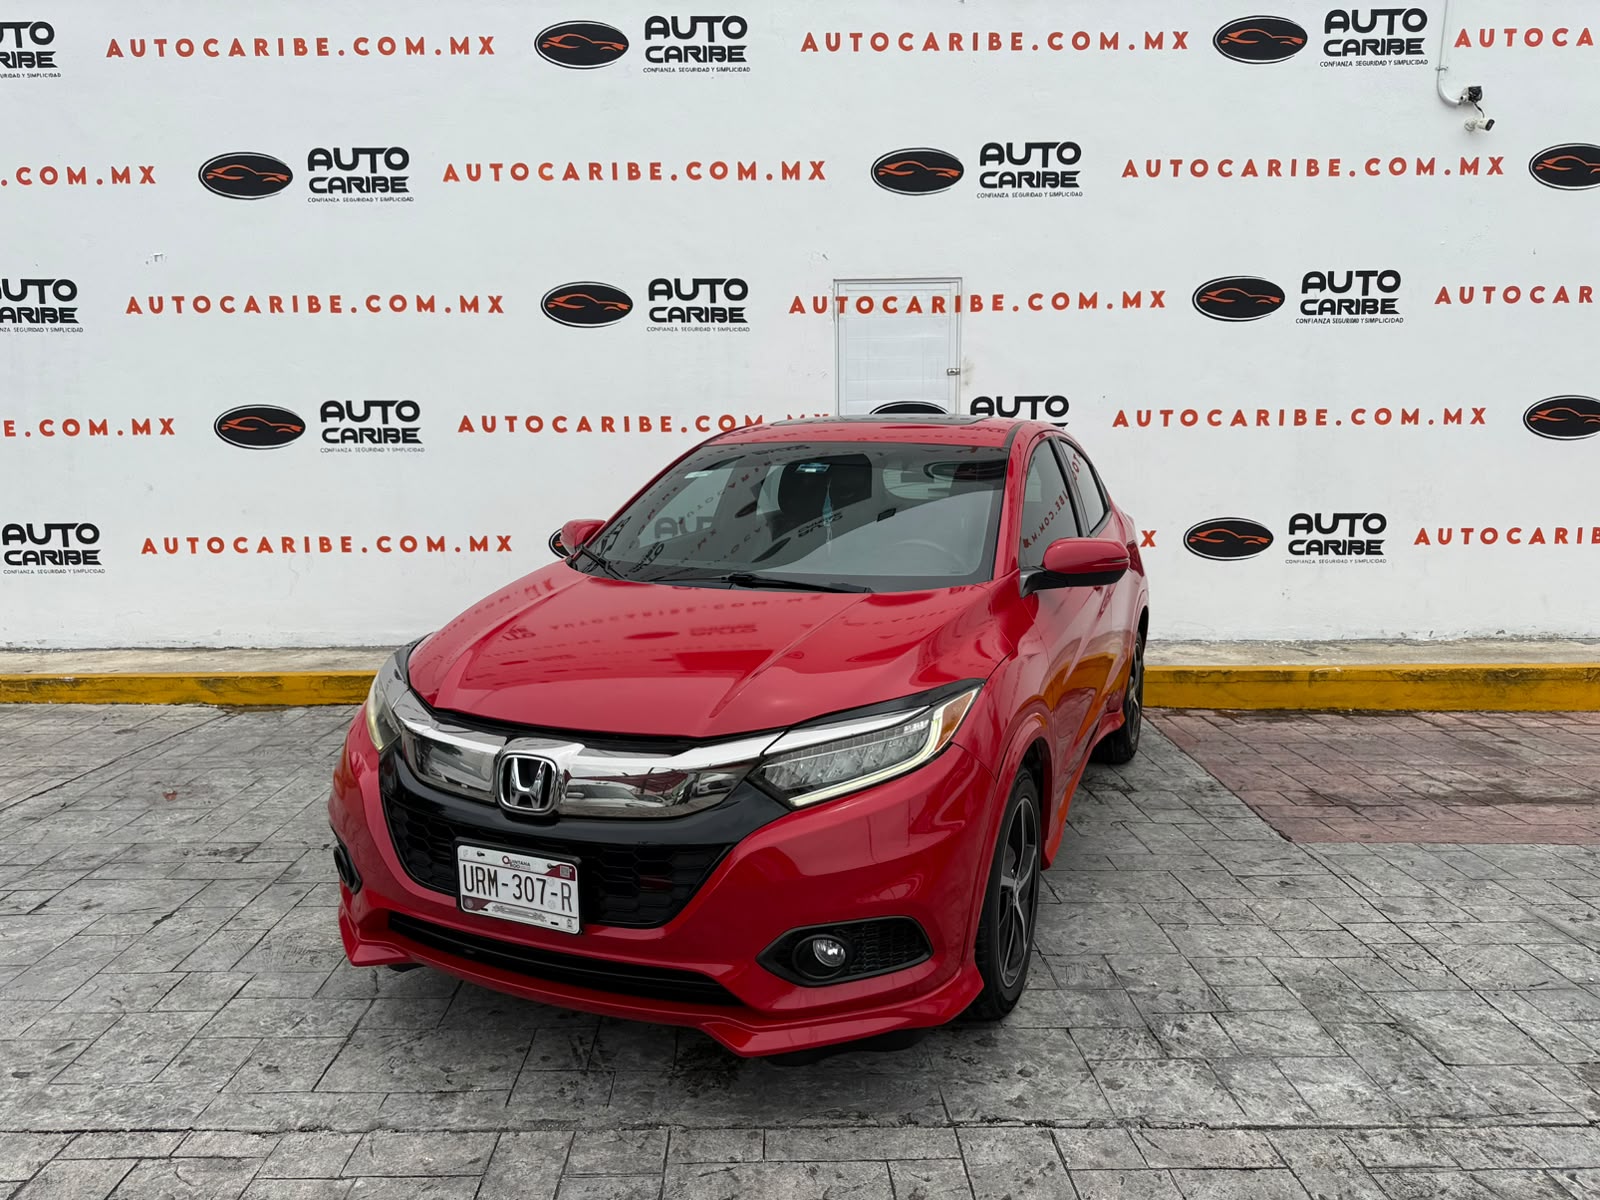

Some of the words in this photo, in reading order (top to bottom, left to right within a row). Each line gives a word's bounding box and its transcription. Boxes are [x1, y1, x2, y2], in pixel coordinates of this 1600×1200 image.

[645, 16, 747, 42] AUTO
[1325, 8, 1427, 35] AUTO
[0, 22, 54, 48] TO
[801, 31, 1188, 53] AUTOCARIBE.COM.MX
[107, 36, 495, 58] AUTOCARIBE.COM.MX
[645, 46, 747, 63] CARIBE
[1324, 38, 1426, 56] CARIBE
[308, 147, 409, 173] AUTO
[980, 142, 1081, 167] AUTO
[443, 160, 826, 183] AUTOCARIBE.COM.MX
[980, 170, 1081, 188] CARIBE
[1122, 157, 1503, 179] AUTOCARIBE.COM.MX
[309, 176, 410, 194] CARIBE
[0, 279, 77, 304] UTO
[649, 278, 748, 303] AUTO
[1302, 270, 1401, 296] AUTO
[126, 294, 503, 315] AUTOCARIBE.COM.MX
[789, 290, 1165, 315] AUTOCARIBE.COM.MX
[1300, 298, 1399, 315] CARIBE
[649, 307, 747, 323] CARIBE
[320, 400, 420, 424] AUTO
[970, 395, 1070, 421] AUTO
[1113, 407, 1486, 428] AUTOCARIBE.COM.MX
[322, 428, 423, 444] CARIBE
[2, 523, 99, 547] AUTO
[1289, 513, 1386, 537] AUTO
[141, 535, 512, 555] AUTOCARIBE.COM.MX
[1288, 540, 1385, 555] CARIBE
[4, 550, 101, 566] CARIBE
[463, 864, 573, 913] URM-307-R
